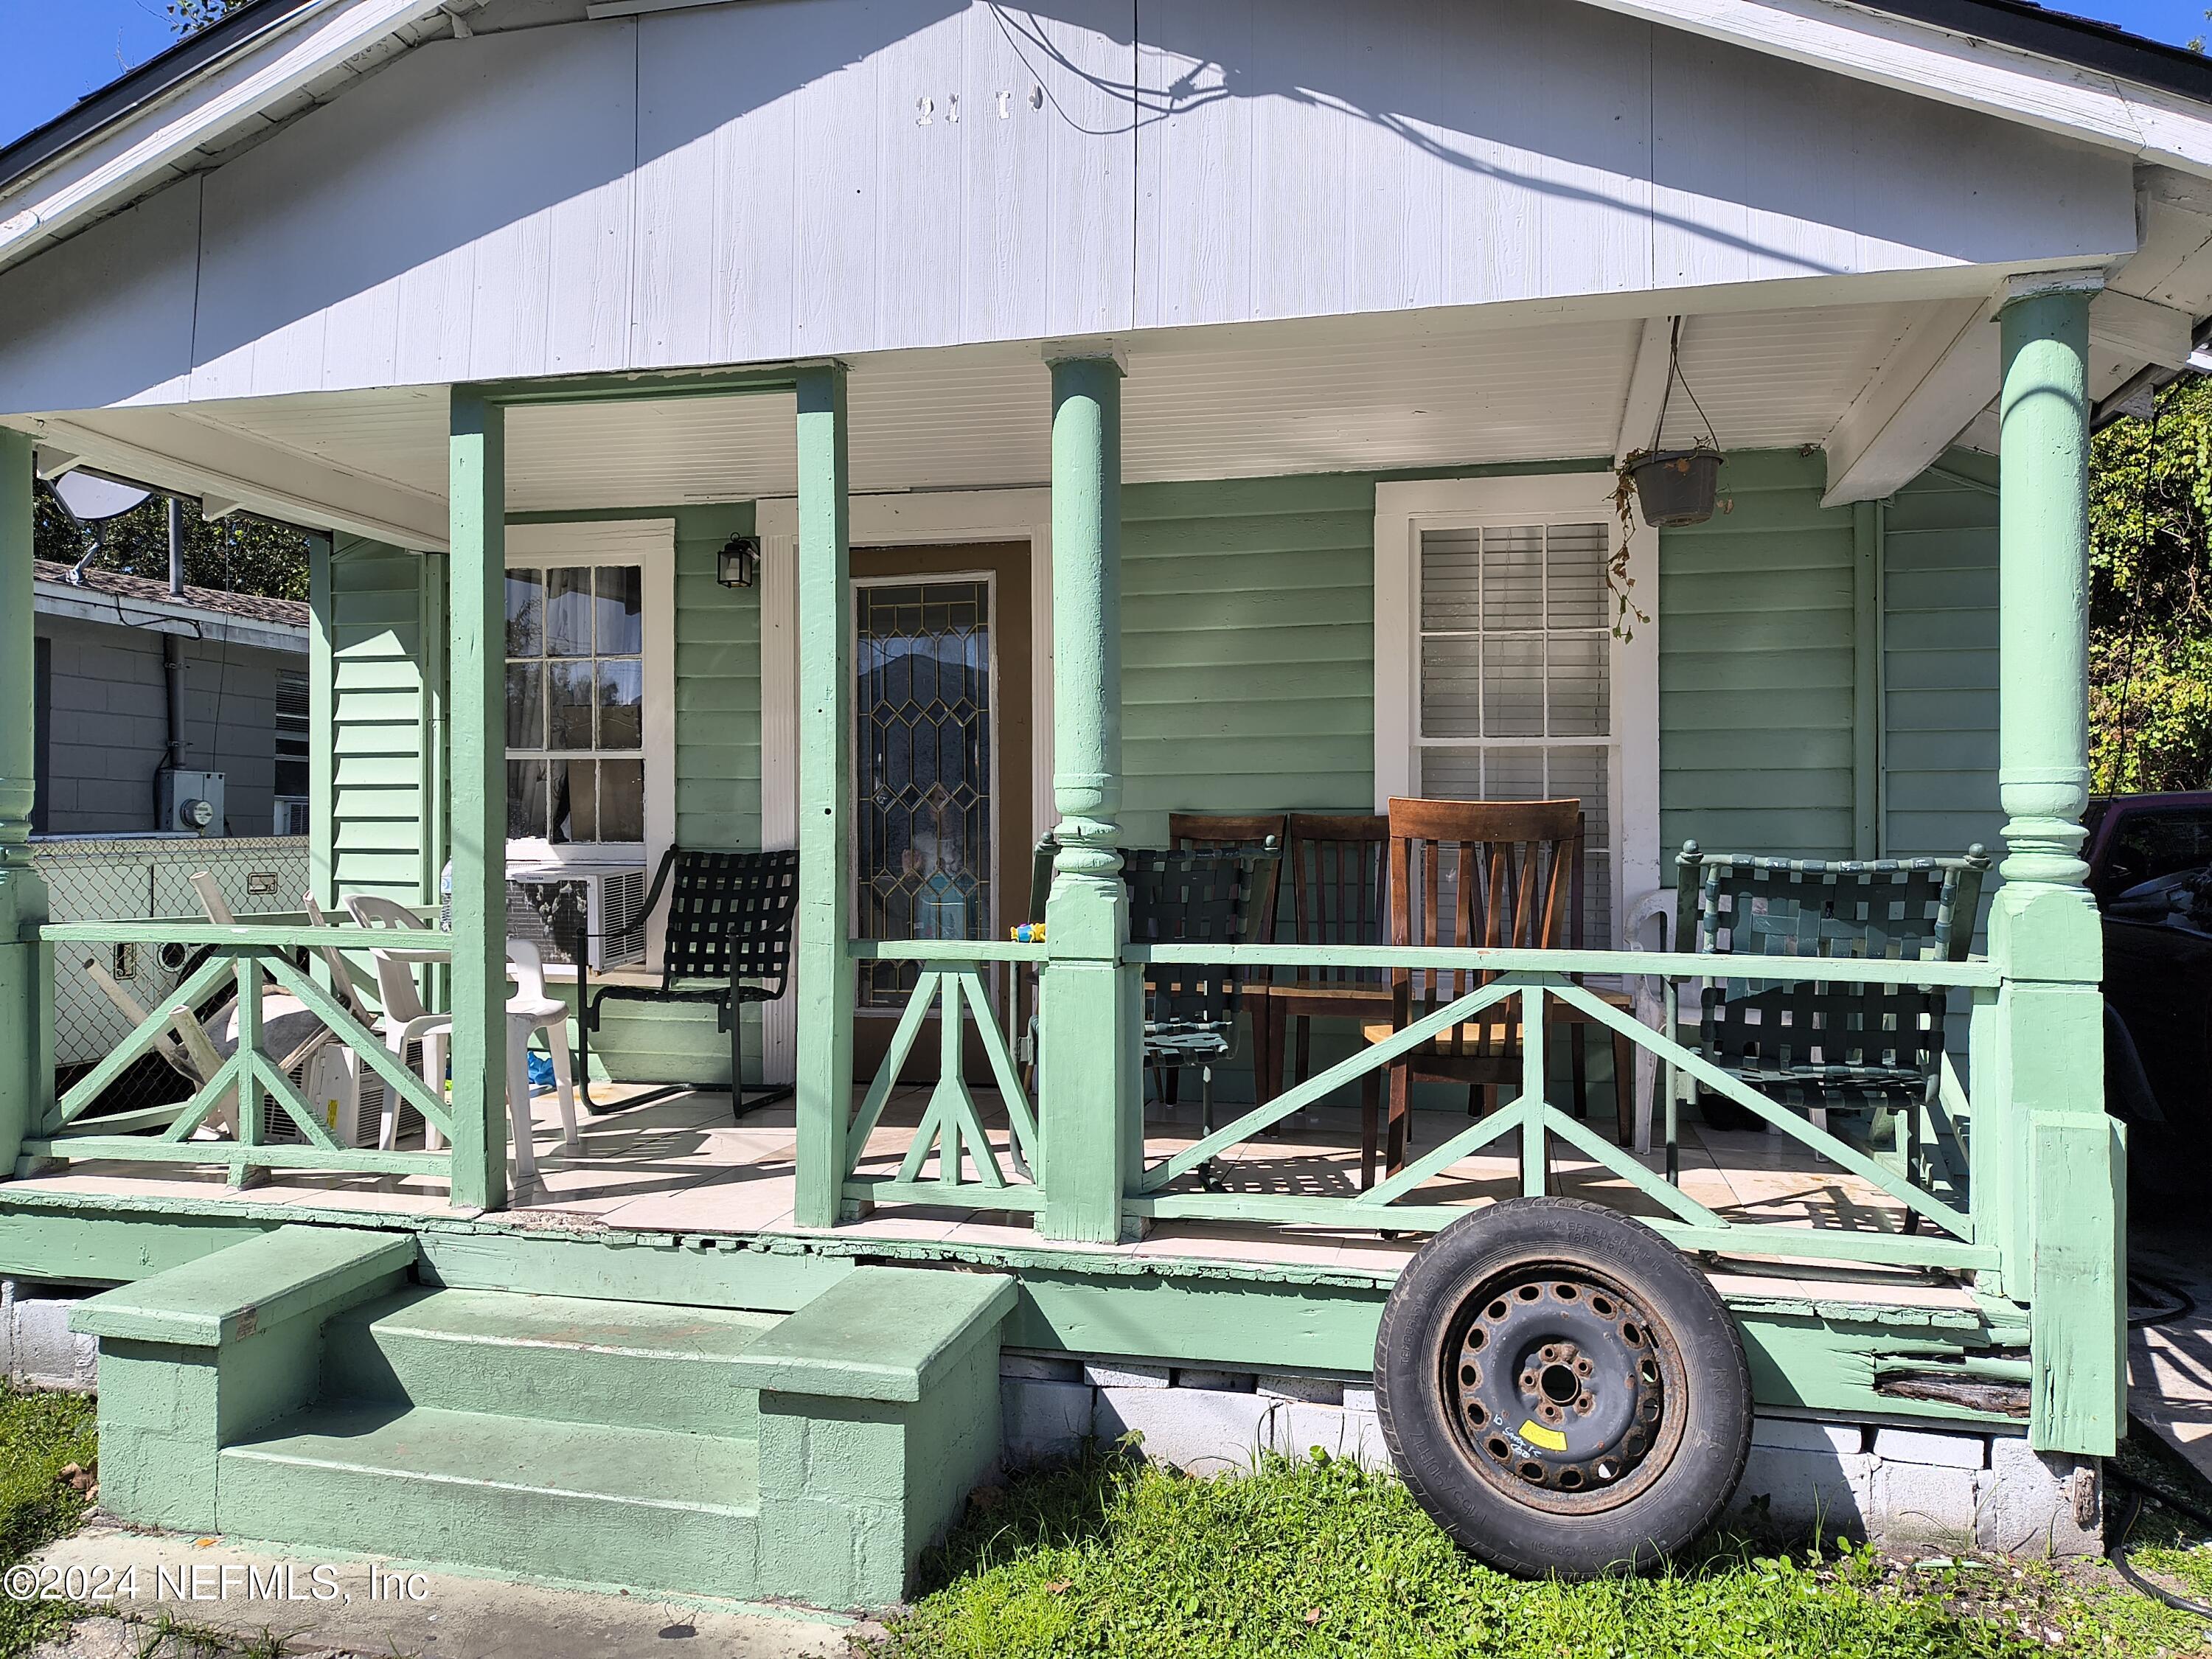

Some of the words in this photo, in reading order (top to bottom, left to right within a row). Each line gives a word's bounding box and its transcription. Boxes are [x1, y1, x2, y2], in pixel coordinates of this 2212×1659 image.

[1536, 1220, 1561, 1230] MAX
[1567, 1222, 1607, 1239] SPEED
[1706, 1368, 1733, 1464] KUMHO
